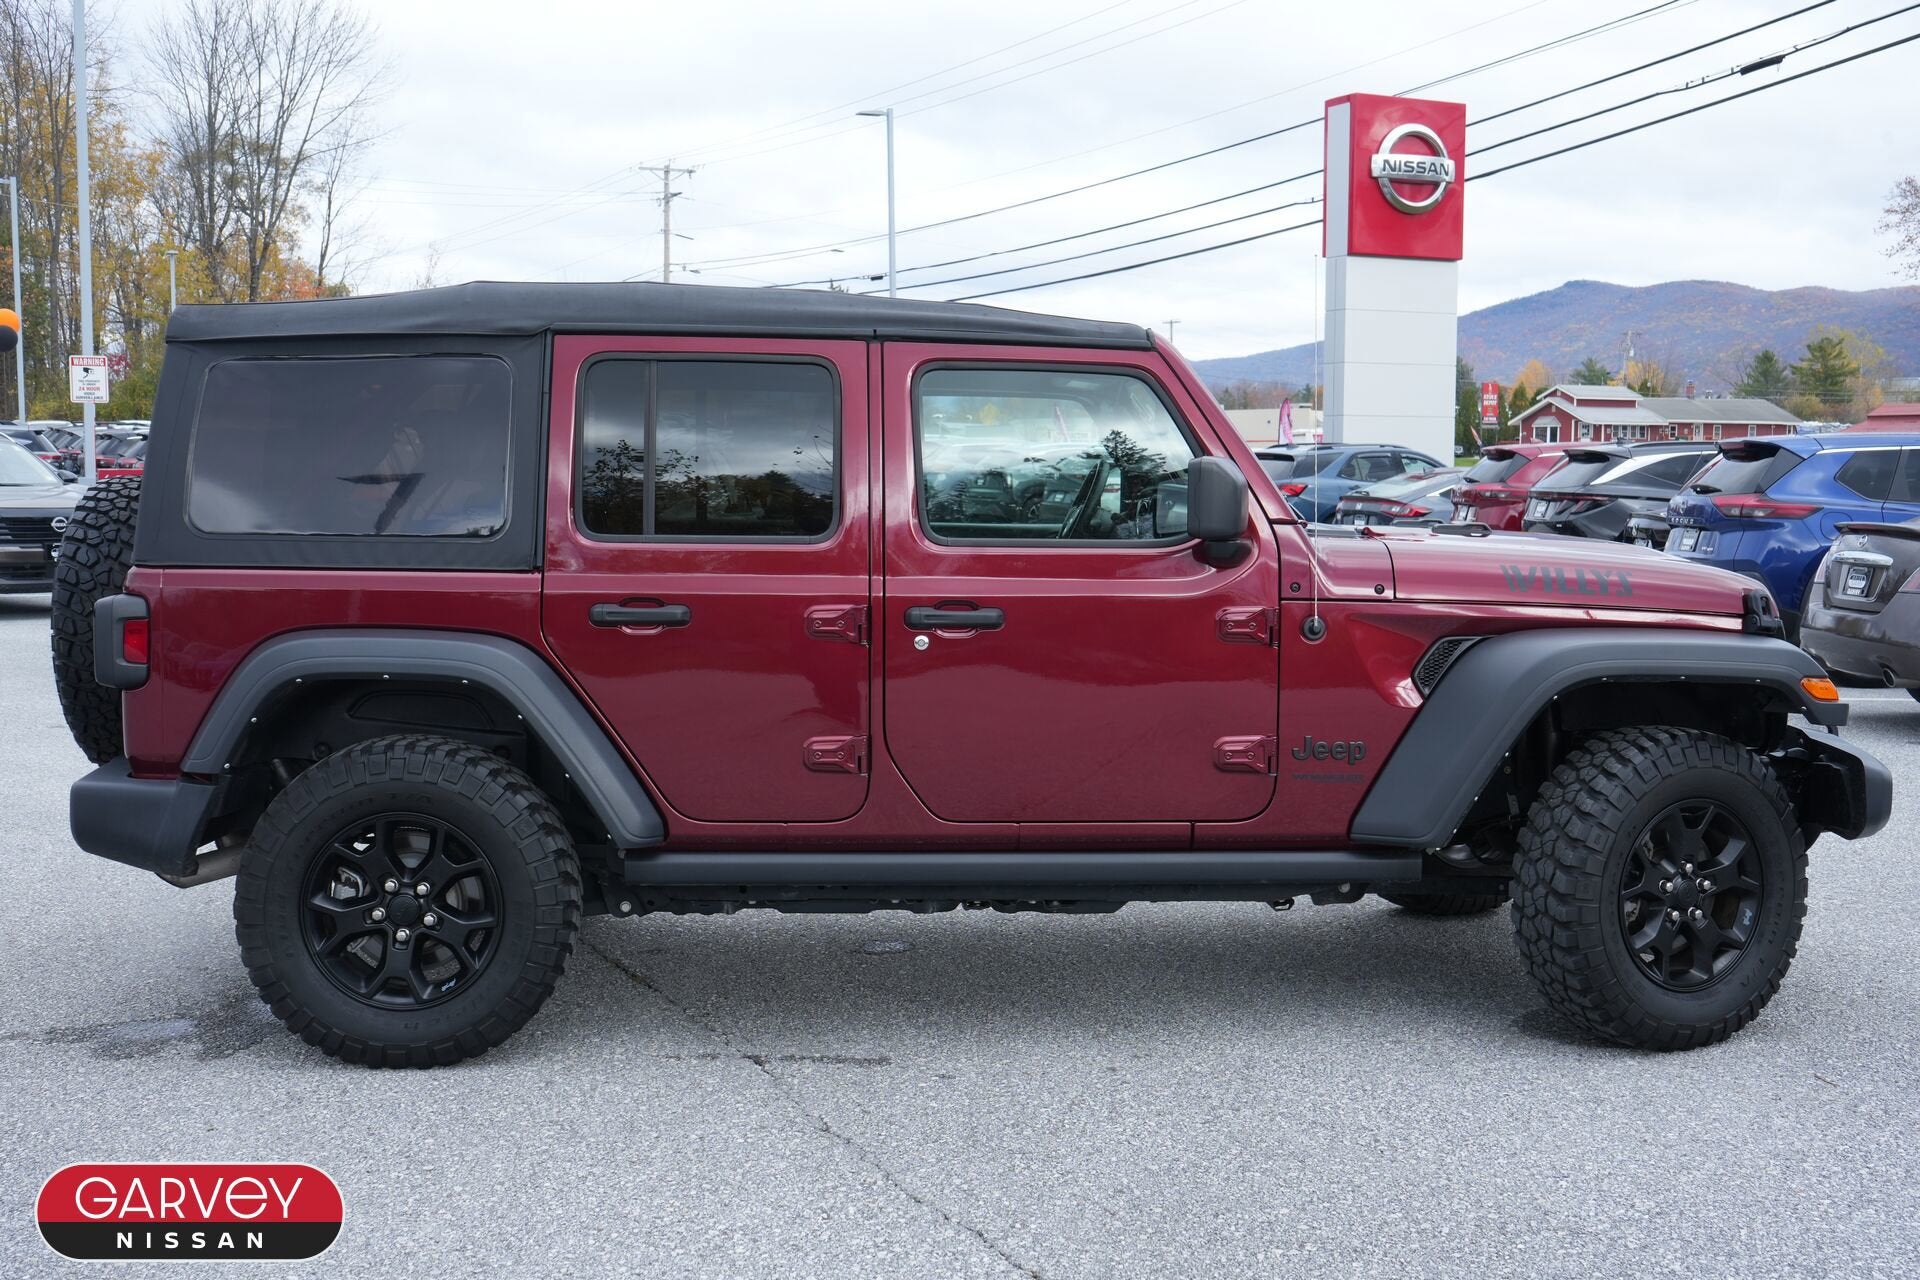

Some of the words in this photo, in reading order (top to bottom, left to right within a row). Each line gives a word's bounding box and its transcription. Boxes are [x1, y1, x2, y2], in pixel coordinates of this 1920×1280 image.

[1382, 159, 1450, 177] NISSAN
[73, 357, 104, 366] WARNING
[1500, 564, 1633, 597] WILLYS
[1291, 735, 1366, 765] Jeep
